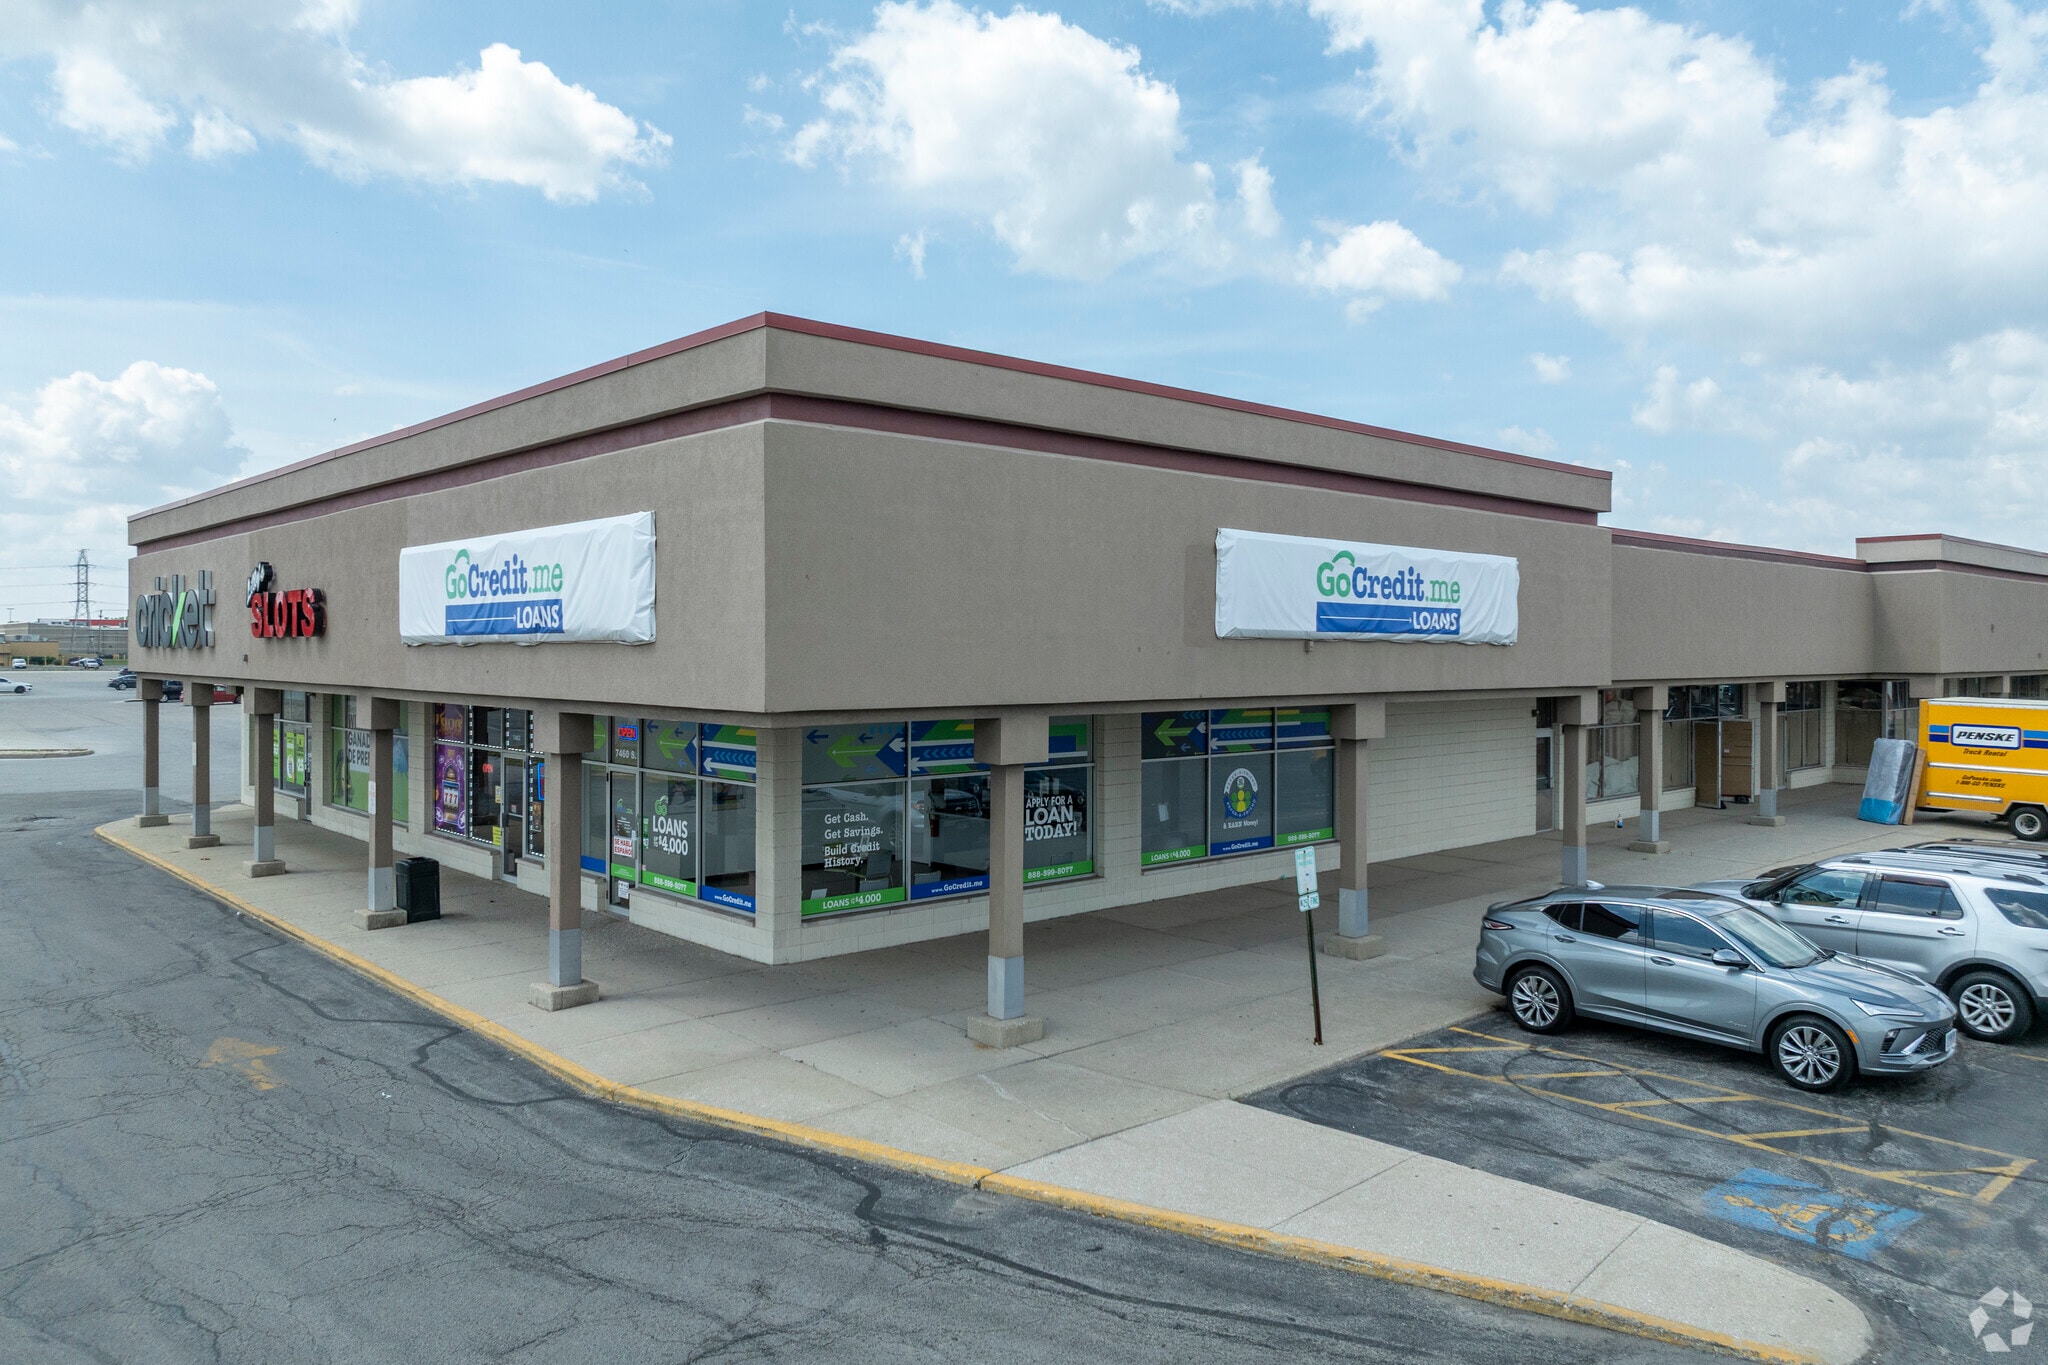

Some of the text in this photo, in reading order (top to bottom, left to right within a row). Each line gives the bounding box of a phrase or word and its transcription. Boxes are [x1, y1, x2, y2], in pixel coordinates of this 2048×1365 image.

[445, 552, 563, 600] GoCredit.me
[1316, 557, 1461, 604] GoCredit.me
[136, 569, 216, 649] cricket
[250, 587, 322, 639] SLOTS
[516, 604, 560, 629] LOANS
[1412, 610, 1458, 632] LOANS
[348, 731, 370, 749] GANAD
[617, 726, 636, 738] OPEN
[1956, 730, 2016, 742] PENSKE
[356, 750, 370, 767] PRE
[1963, 748, 2008, 757] Truck Rental
[654, 797, 668, 816] Go
[1026, 794, 1073, 809] APPLY FOR A
[824, 812, 869, 825] Get Cash.
[1025, 805, 1074, 826] LOAN
[652, 815, 689, 839] LOANS
[824, 826, 883, 840] Get Savings.
[1025, 820, 1077, 842] TODAY!
[658, 835, 689, 856] $4,000
[824, 841, 881, 857] Build Credit
[824, 855, 864, 868] History.
[1151, 852, 1170, 862] LOANS
[822, 898, 850, 910] LOANS
